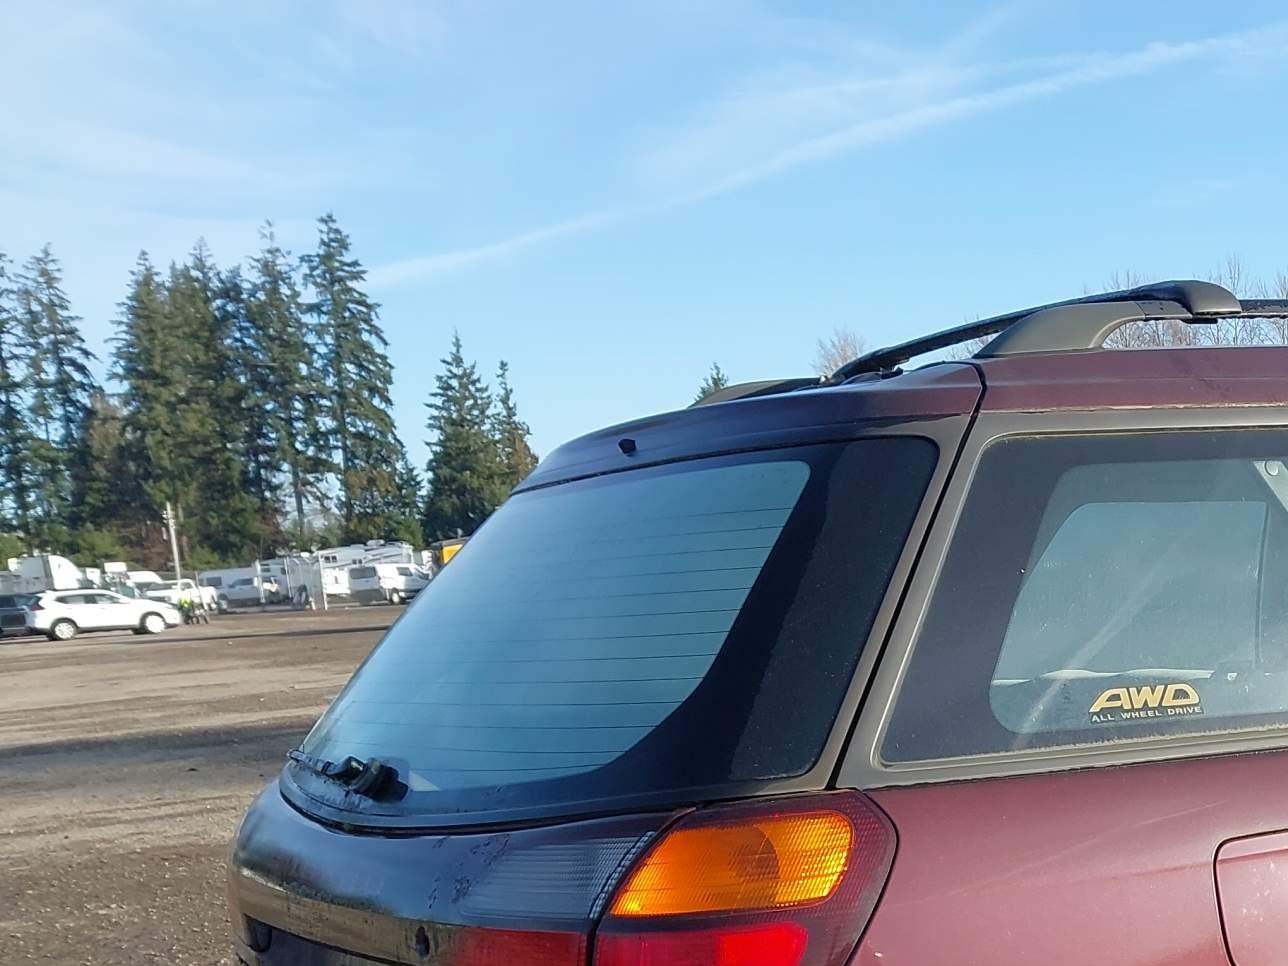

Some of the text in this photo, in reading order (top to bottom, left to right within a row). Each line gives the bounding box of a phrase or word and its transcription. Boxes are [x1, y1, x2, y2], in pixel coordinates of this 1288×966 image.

[1089, 683, 1200, 713] AWD
[1092, 706, 1202, 723] ALL WHEEL DRIVE
